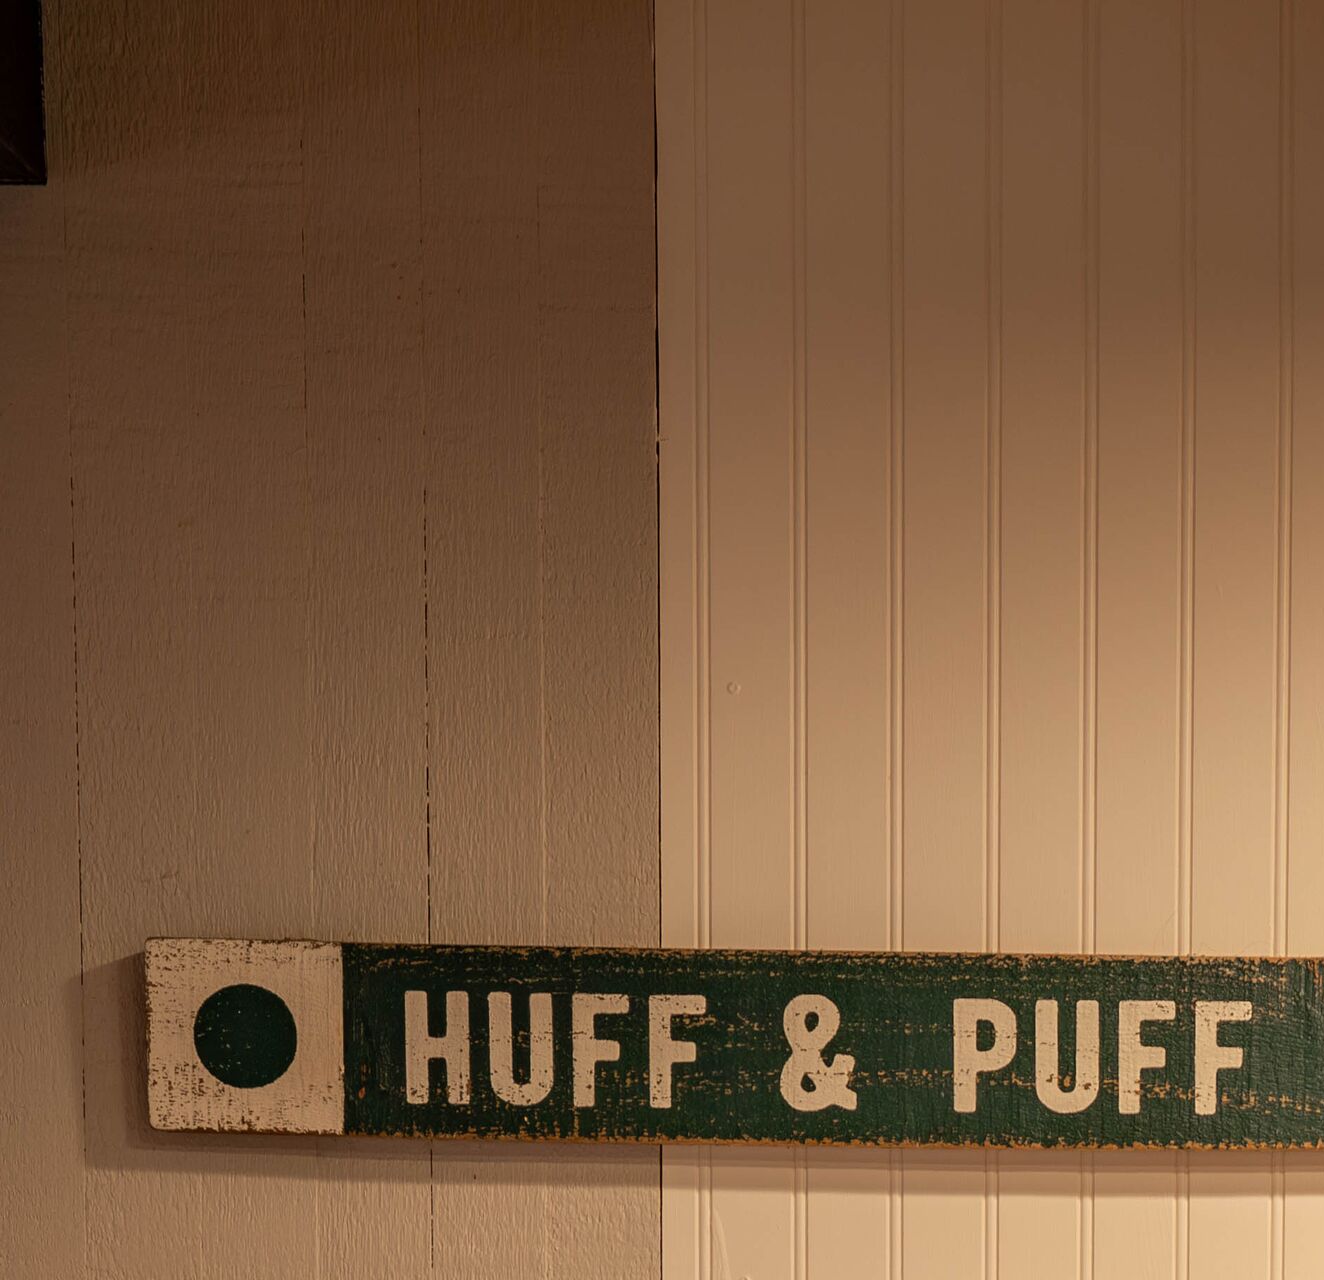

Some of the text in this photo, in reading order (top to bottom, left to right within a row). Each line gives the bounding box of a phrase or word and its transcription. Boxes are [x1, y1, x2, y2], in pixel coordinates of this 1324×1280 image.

[403, 989, 1253, 1116] HUFF & PUFF
